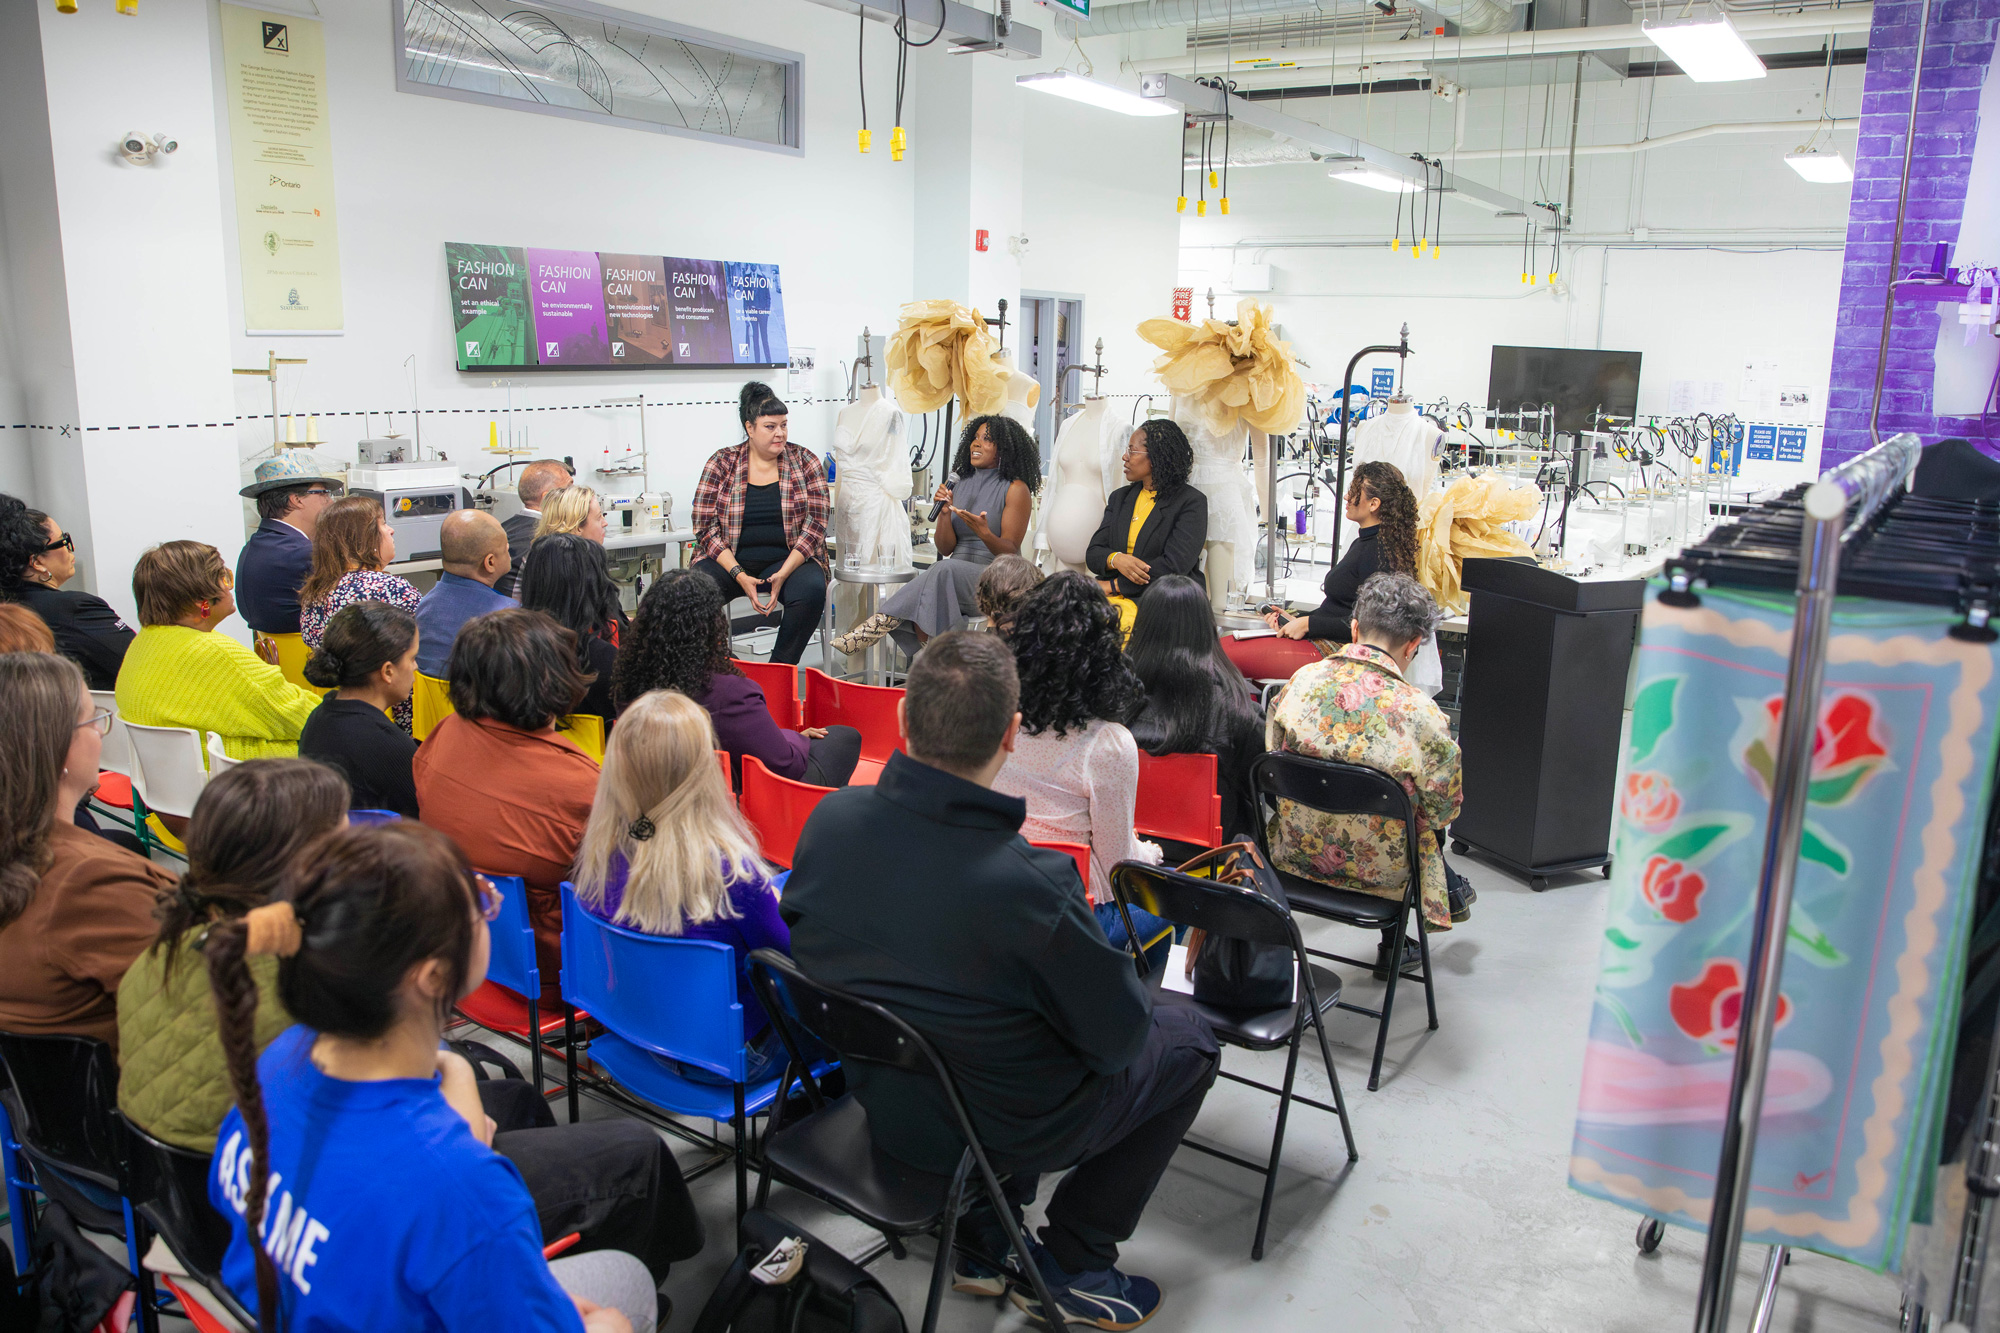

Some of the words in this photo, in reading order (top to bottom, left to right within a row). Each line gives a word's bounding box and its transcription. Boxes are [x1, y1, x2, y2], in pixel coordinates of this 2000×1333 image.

[266, 25, 273, 36] F
[276, 37, 285, 48] X
[458, 260, 515, 276] FASHION
[539, 265, 591, 279] FASHION
[606, 268, 655, 282] FASHION
[672, 272, 716, 286] FASHION
[459, 277, 488, 290] CAN
[540, 280, 566, 293] CAN
[732, 276, 773, 288] FASHION
[608, 283, 632, 295] CAN
[674, 287, 696, 298] CAN
[734, 290, 754, 301] CAN
[550, 302, 592, 310] environmentally
[265, 1190, 331, 1296] ME
